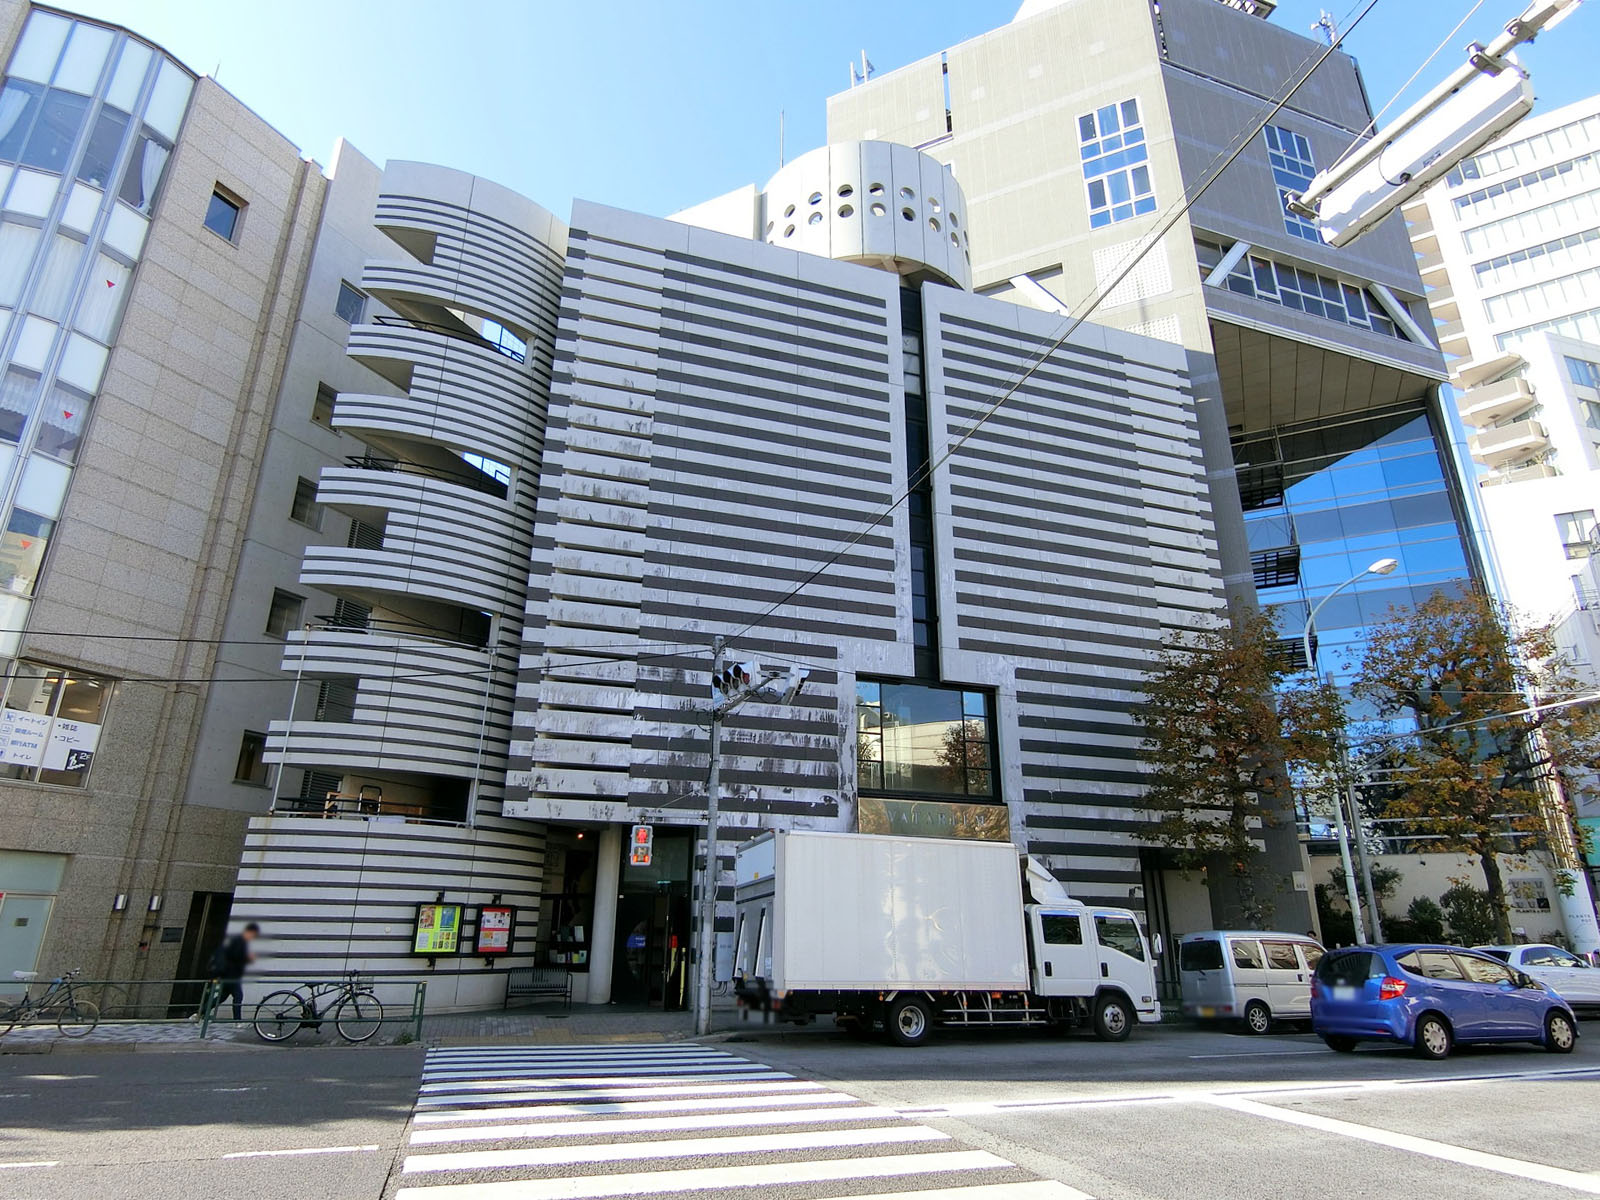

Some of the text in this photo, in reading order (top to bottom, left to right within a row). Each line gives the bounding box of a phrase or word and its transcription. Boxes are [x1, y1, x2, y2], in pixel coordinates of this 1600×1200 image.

[59, 735, 80, 744] コピー
[13, 752, 32, 760] トイレ
[80, 752, 91, 760] 2F
